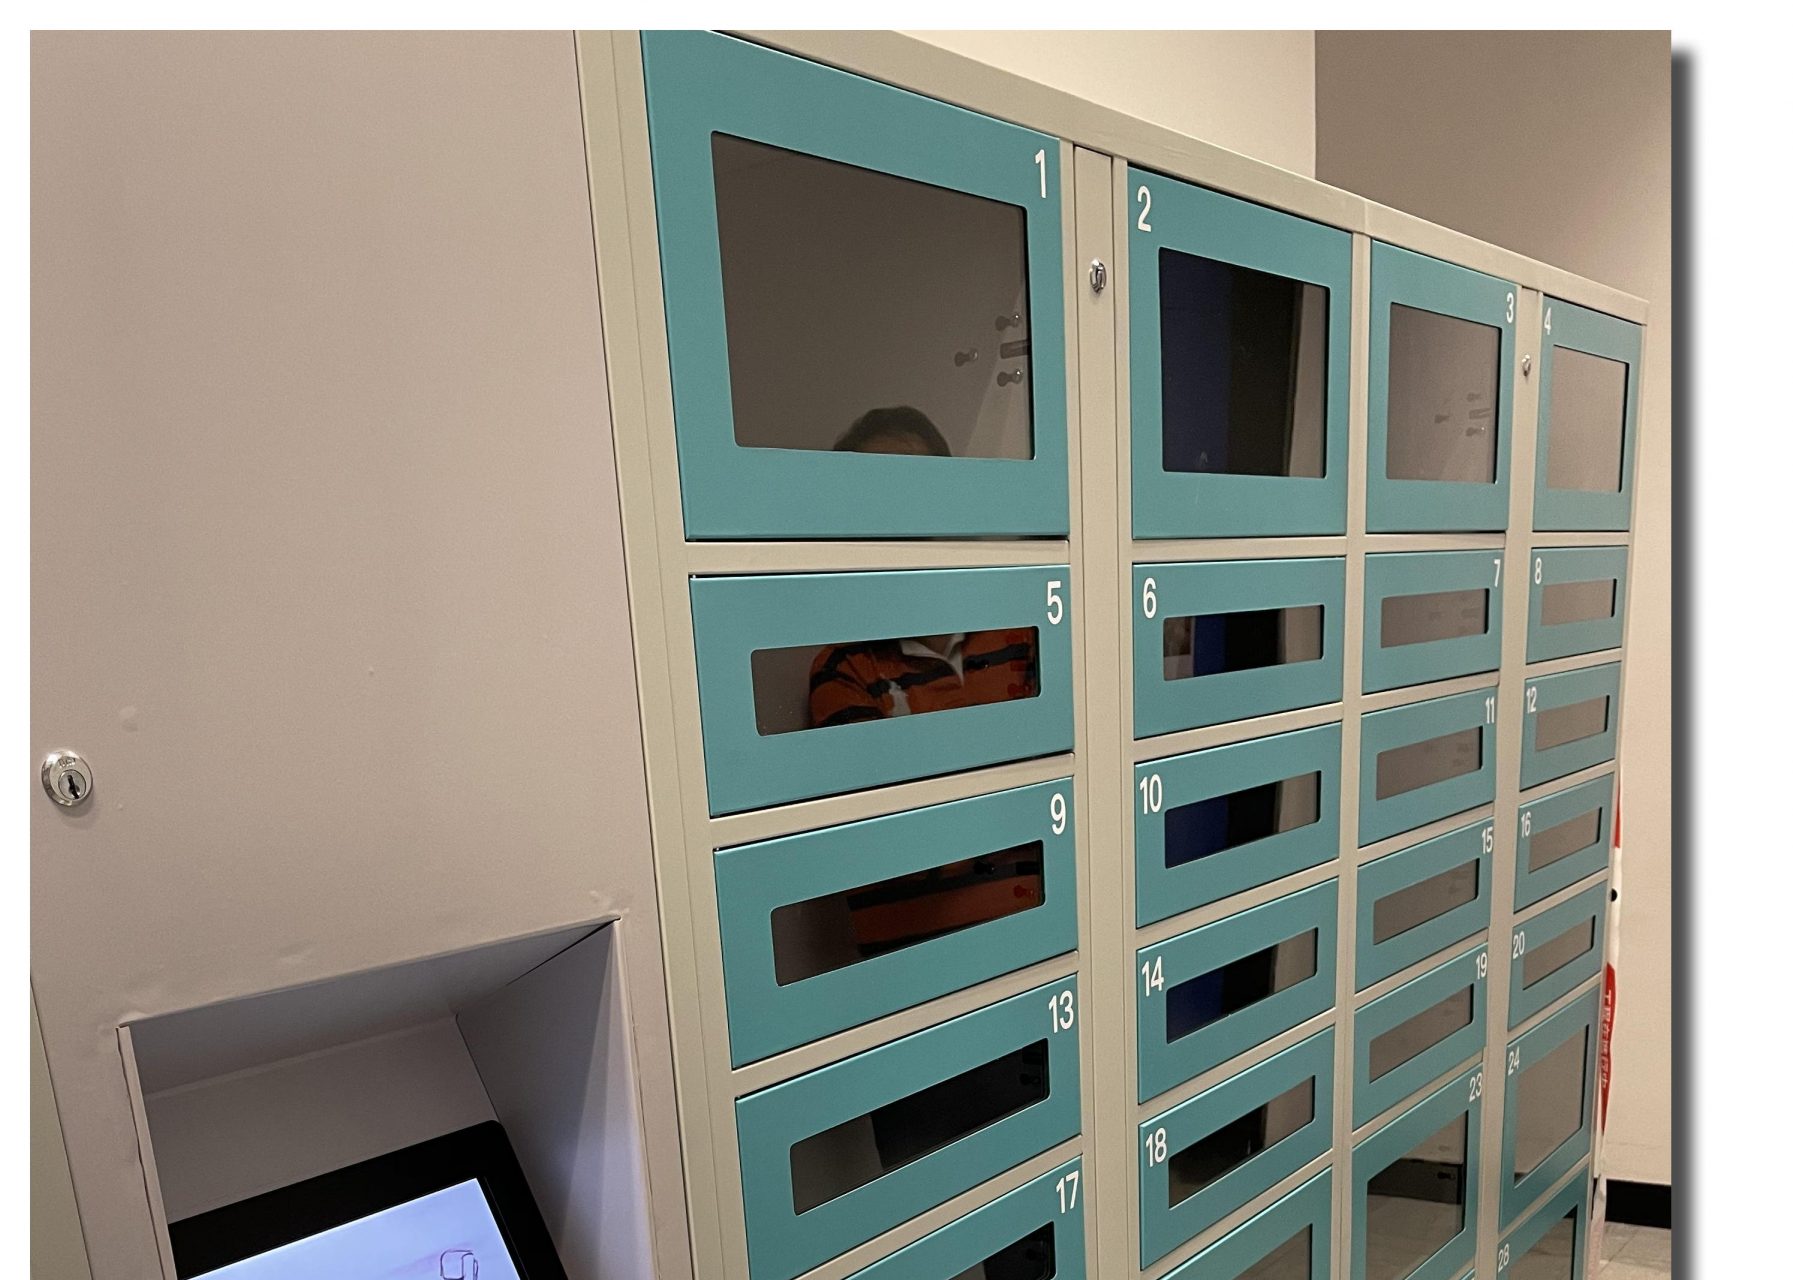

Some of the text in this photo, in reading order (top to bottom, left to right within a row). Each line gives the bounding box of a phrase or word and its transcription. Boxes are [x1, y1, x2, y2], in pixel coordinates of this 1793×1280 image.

[1035, 149, 1047, 199] 1
[1137, 186, 1152, 233] 2
[1506, 291, 1515, 323] 3
[1543, 306, 1551, 336] 4
[1494, 559, 1501, 588] 7
[1534, 556, 1542, 585] 8
[1046, 580, 1063, 625] 5
[1142, 577, 1157, 619] 6
[1485, 697, 1496, 724] 11
[1526, 686, 1537, 714] 12
[1138, 772, 1163, 815] 10
[1051, 793, 1067, 834] 9
[1520, 810, 1532, 837] 16
[1482, 827, 1494, 854] 15
[1511, 931, 1525, 959] 20
[1141, 956, 1164, 997] 14
[1476, 952, 1488, 979] 19
[1048, 990, 1074, 1032] 13
[1507, 1047, 1520, 1076] 24
[1469, 1071, 1484, 1102] 23
[1145, 1127, 1167, 1168] 18
[1056, 1170, 1080, 1213] 17
[1497, 1243, 1510, 1273] 28
